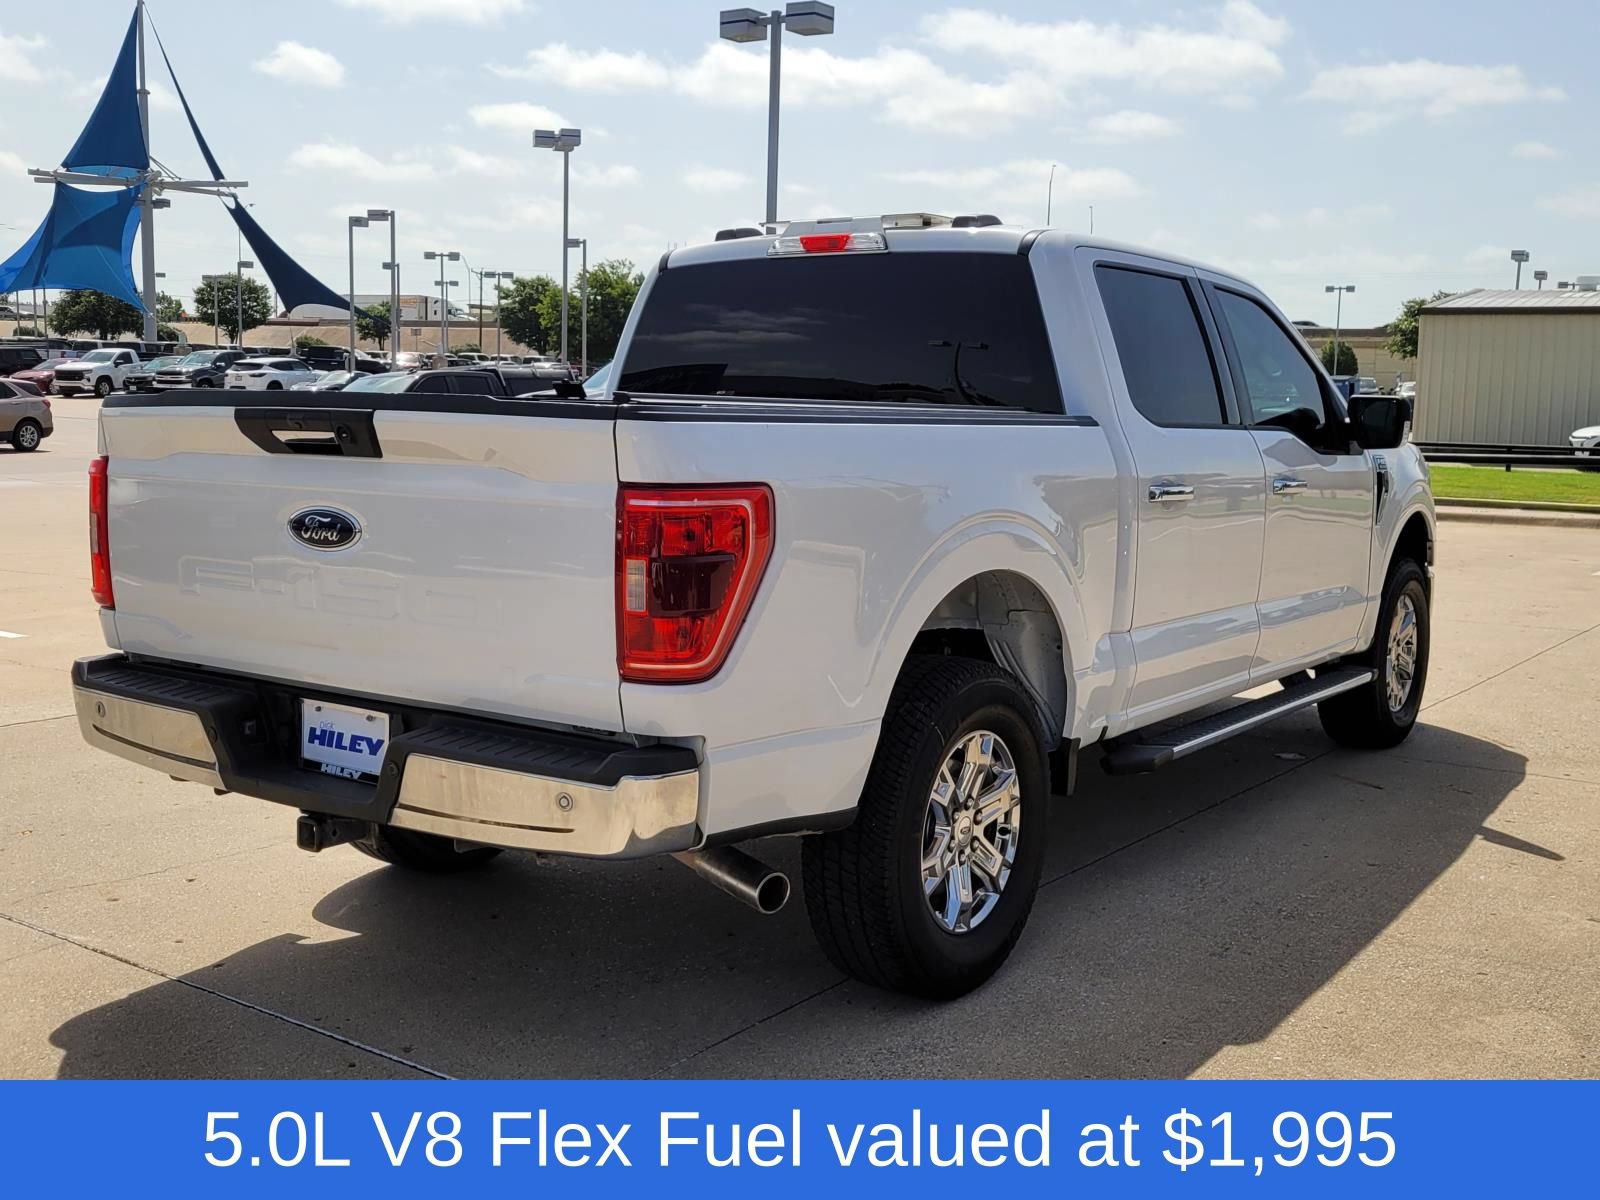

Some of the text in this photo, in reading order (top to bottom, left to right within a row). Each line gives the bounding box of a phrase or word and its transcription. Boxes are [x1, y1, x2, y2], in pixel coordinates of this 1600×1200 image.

[301, 515, 340, 541] Ford
[307, 726, 385, 756] HILEY
[321, 762, 362, 779] HILEY
